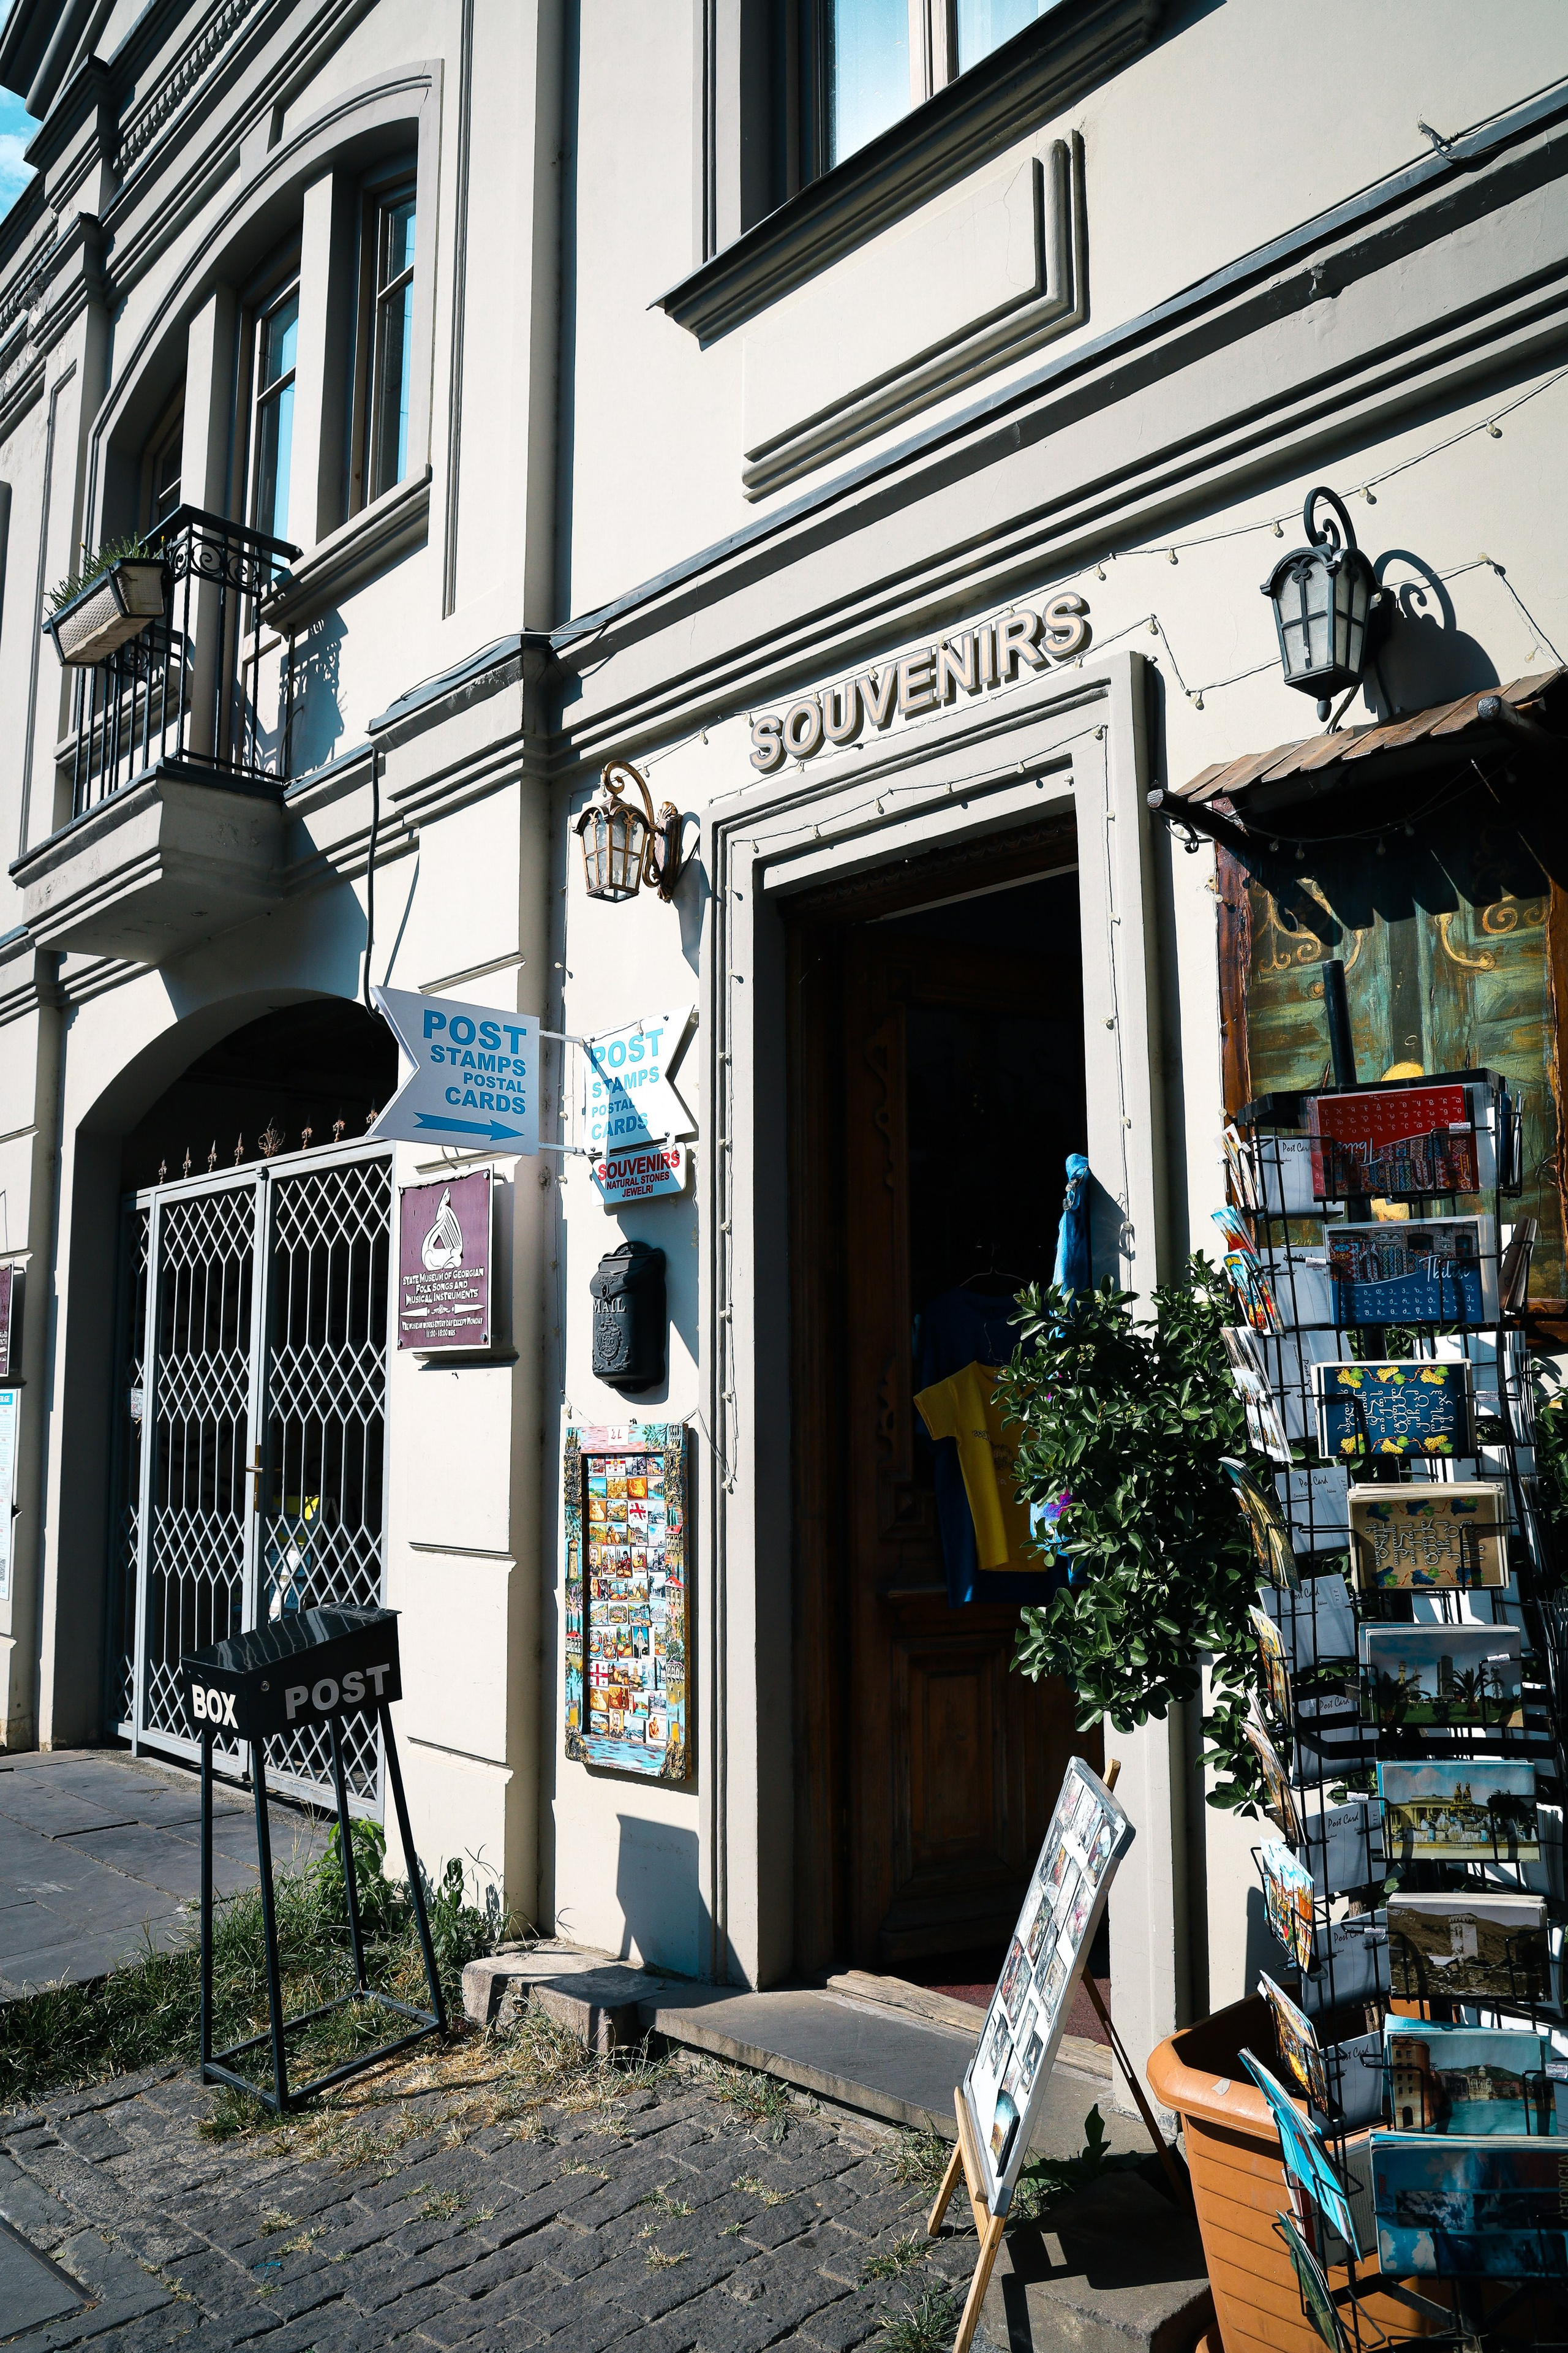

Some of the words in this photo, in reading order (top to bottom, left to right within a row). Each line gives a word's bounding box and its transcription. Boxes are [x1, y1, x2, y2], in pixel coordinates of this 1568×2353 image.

[749, 591, 1087, 771] SOUVENIRS
[423, 1009, 527, 1055] POST
[430, 1045, 527, 1077] STAMPS
[591, 1028, 663, 1074] POST
[464, 1072, 526, 1094] POSTAL
[592, 1066, 660, 1098] STAMPS
[445, 1086, 526, 1116] CARDS
[592, 1098, 636, 1118] POSTAL
[591, 1112, 648, 1140] CARDS
[1283, 1143, 1295, 1152] Post
[1297, 1143, 1310, 1152] Car
[598, 1150, 680, 1181] SOUVENIRS
[606, 1178, 639, 1190] NATURAL
[640, 1171, 669, 1184] STONES
[622, 1184, 653, 1198] JEWELRI
[402, 1274, 420, 1285] STATE
[420, 1272, 444, 1283] MUSEUM
[444, 1271, 453, 1280] OF
[453, 1267, 484, 1279] GEORGIAN
[416, 1284, 432, 1294] FOLK
[432, 1281, 453, 1292] SONGS
[454, 1280, 468, 1290] AND
[405, 1293, 433, 1307] MUSICAL
[434, 1288, 479, 1302] INSTRUMENTS
[592, 1297, 627, 1314] MAIL
[1313, 1475, 1329, 1485] Card
[285, 1663, 390, 1720] POST
[192, 1683, 239, 1729] BOX
[1320, 1699, 1333, 1711] Post
[1328, 1817, 1341, 1829] Post
[1343, 1811, 1359, 1824] Card
[1333, 1931, 1348, 1944] Post
